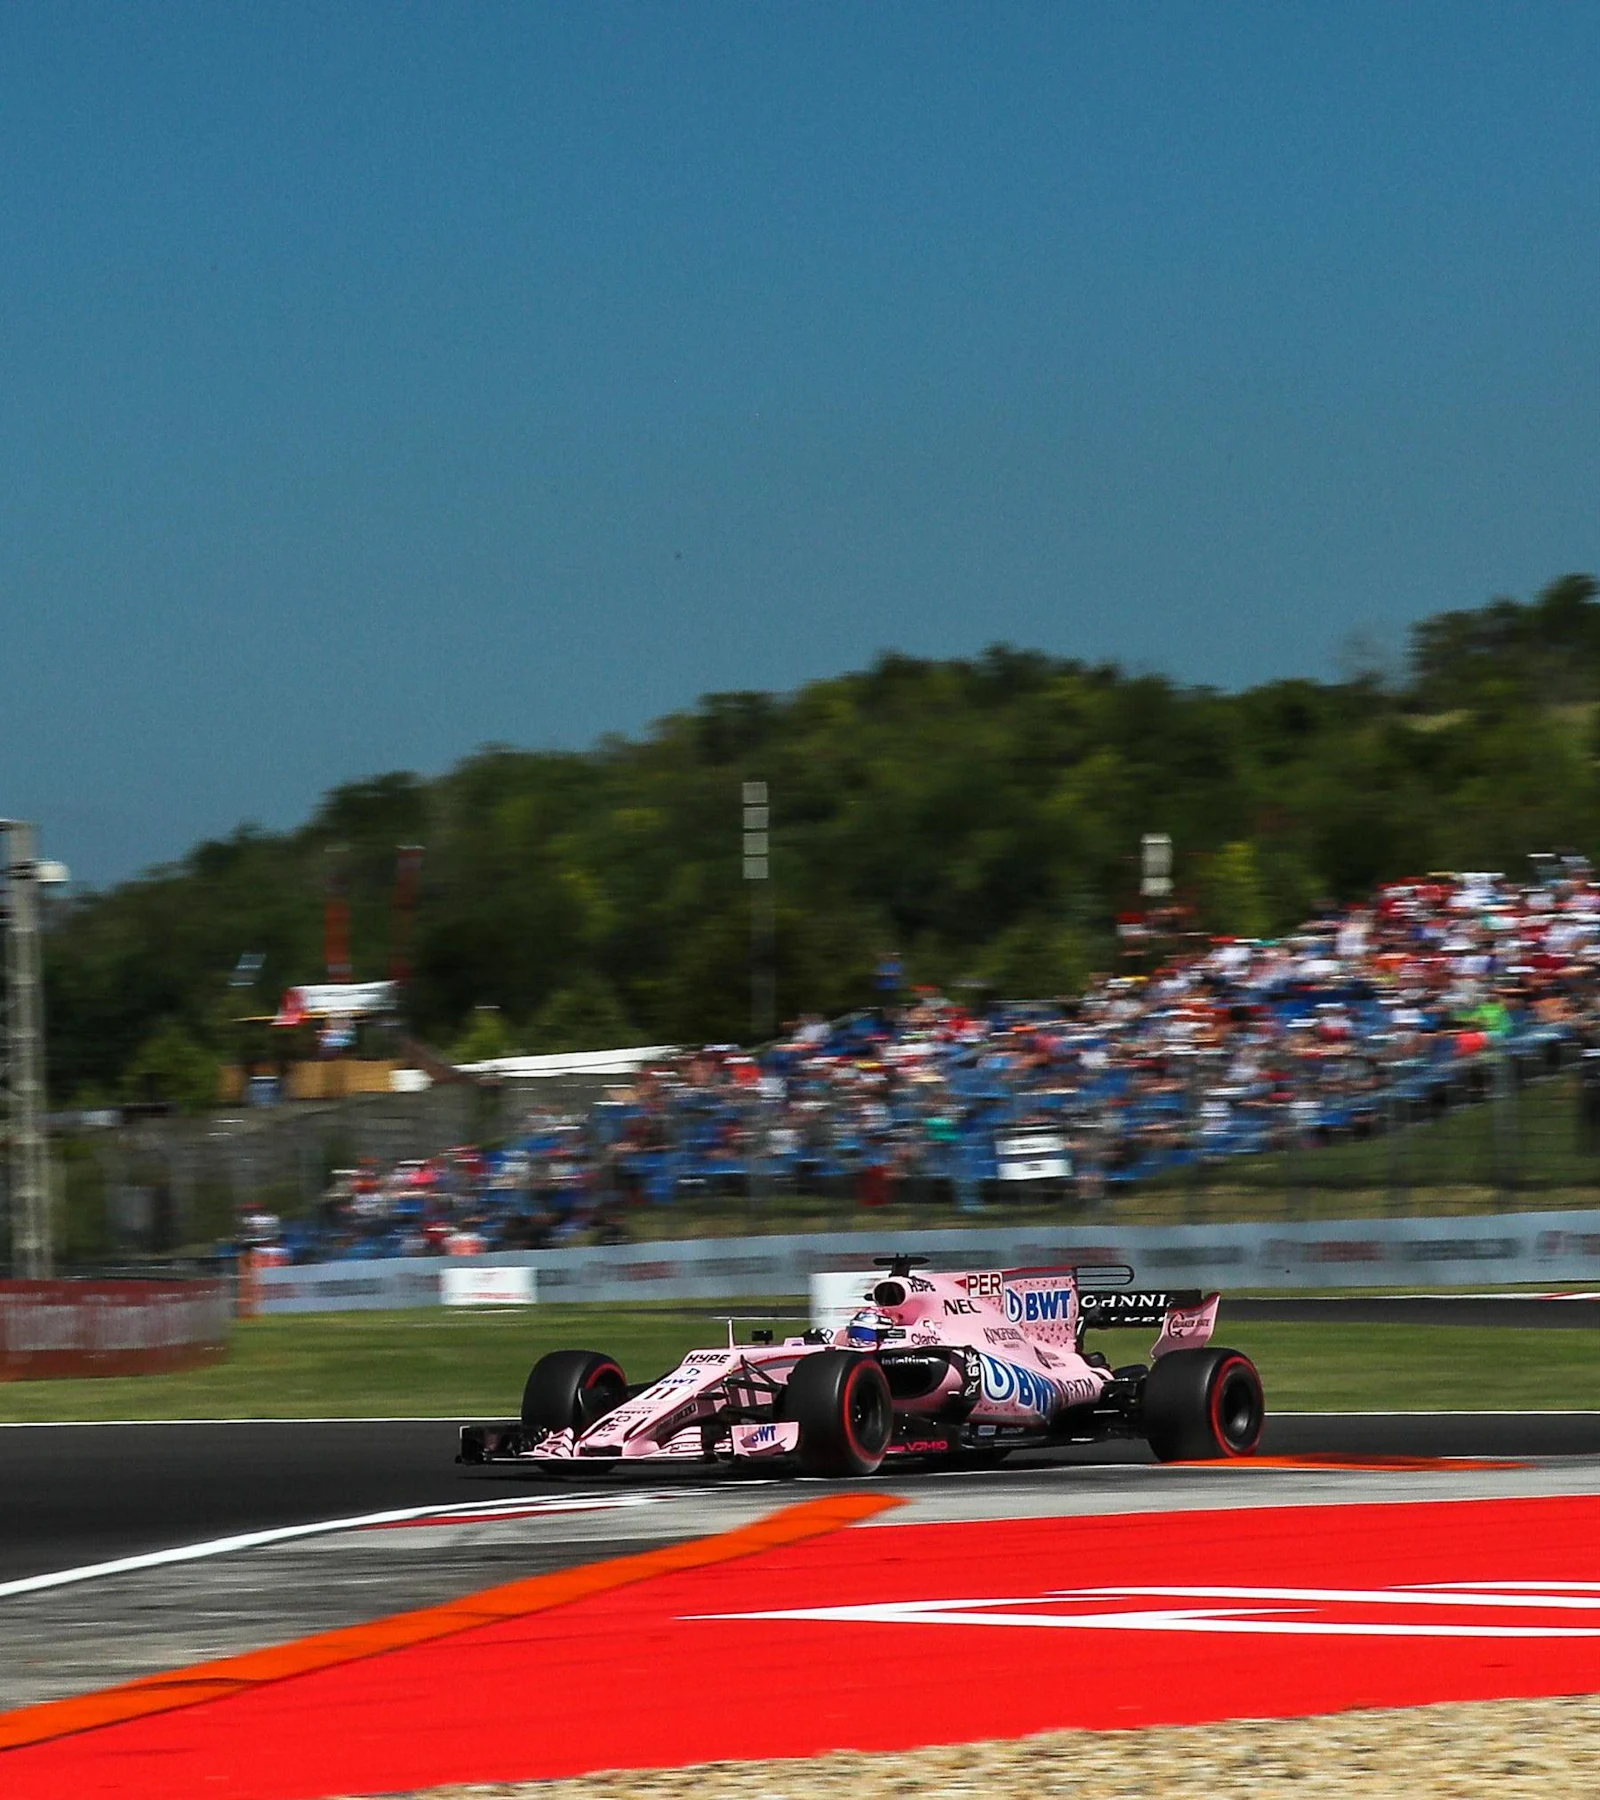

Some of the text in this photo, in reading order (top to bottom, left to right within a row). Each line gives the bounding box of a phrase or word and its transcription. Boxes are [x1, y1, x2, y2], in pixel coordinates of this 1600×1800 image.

[908, 1277, 936, 1292] HYPE
[968, 1274, 1000, 1294] PER
[944, 1299, 981, 1315] NEC
[1026, 1290, 1071, 1321] BWT
[686, 1354, 731, 1364] HYPE
[643, 1387, 679, 1400] 11
